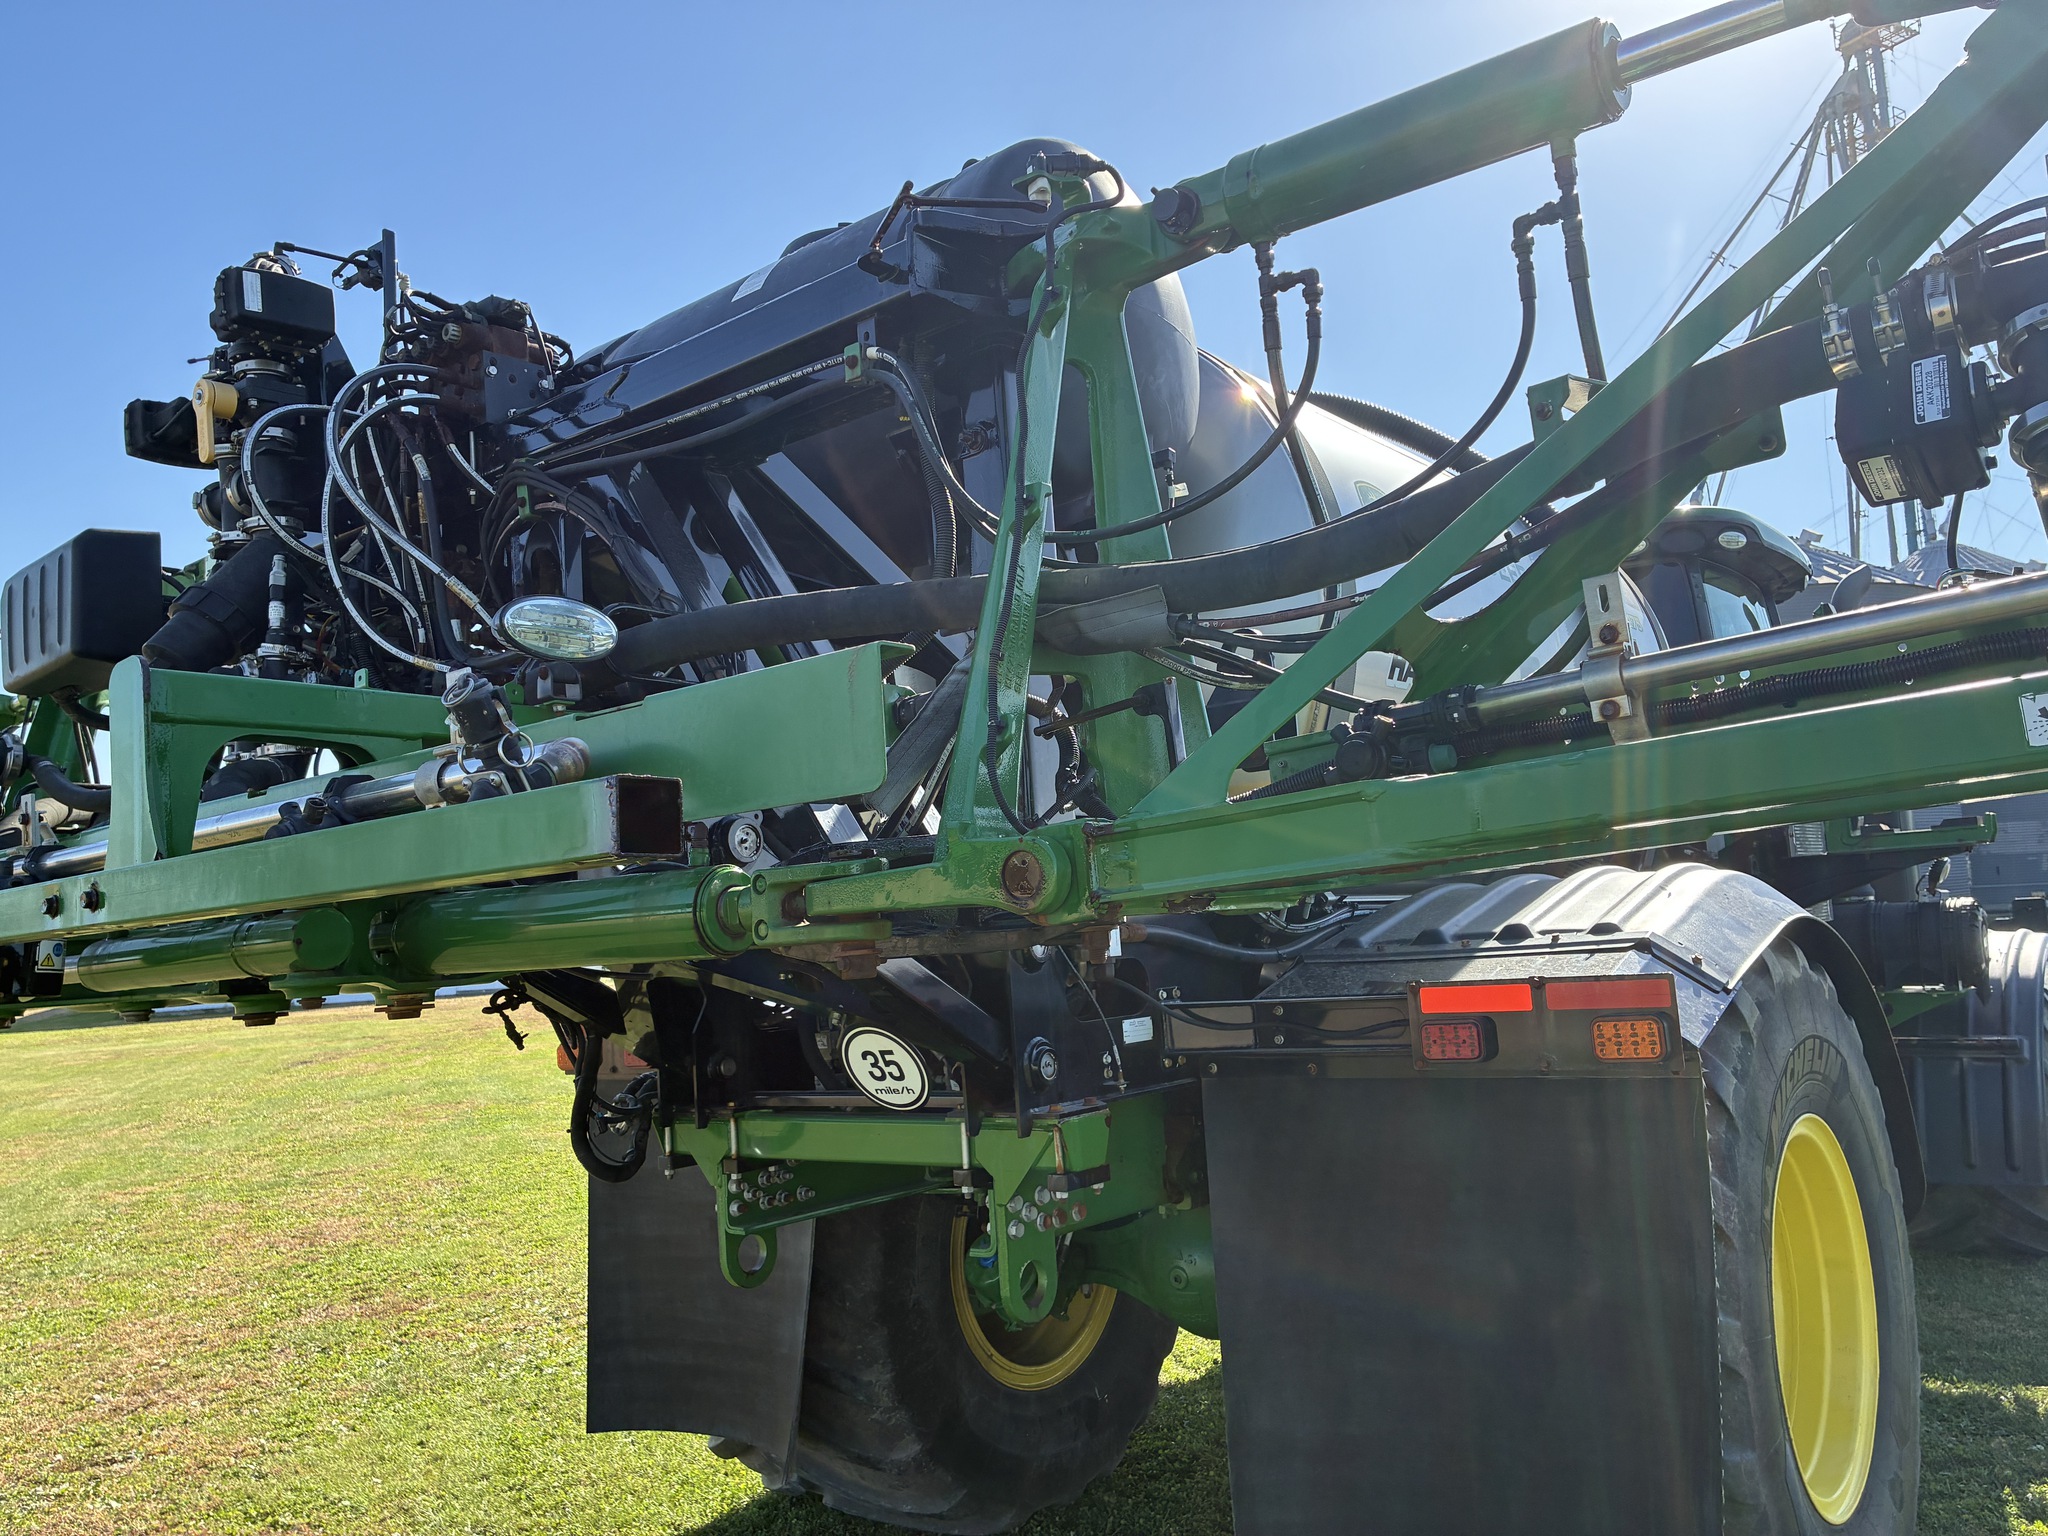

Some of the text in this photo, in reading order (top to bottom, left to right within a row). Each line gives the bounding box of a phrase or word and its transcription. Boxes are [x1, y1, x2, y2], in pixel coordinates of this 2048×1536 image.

[1914, 365, 1925, 417] JOHN DEERE
[1861, 463, 1882, 498] JOHN DEERE
[861, 1049, 906, 1082] 35
[874, 1086, 916, 1095] mile/h
